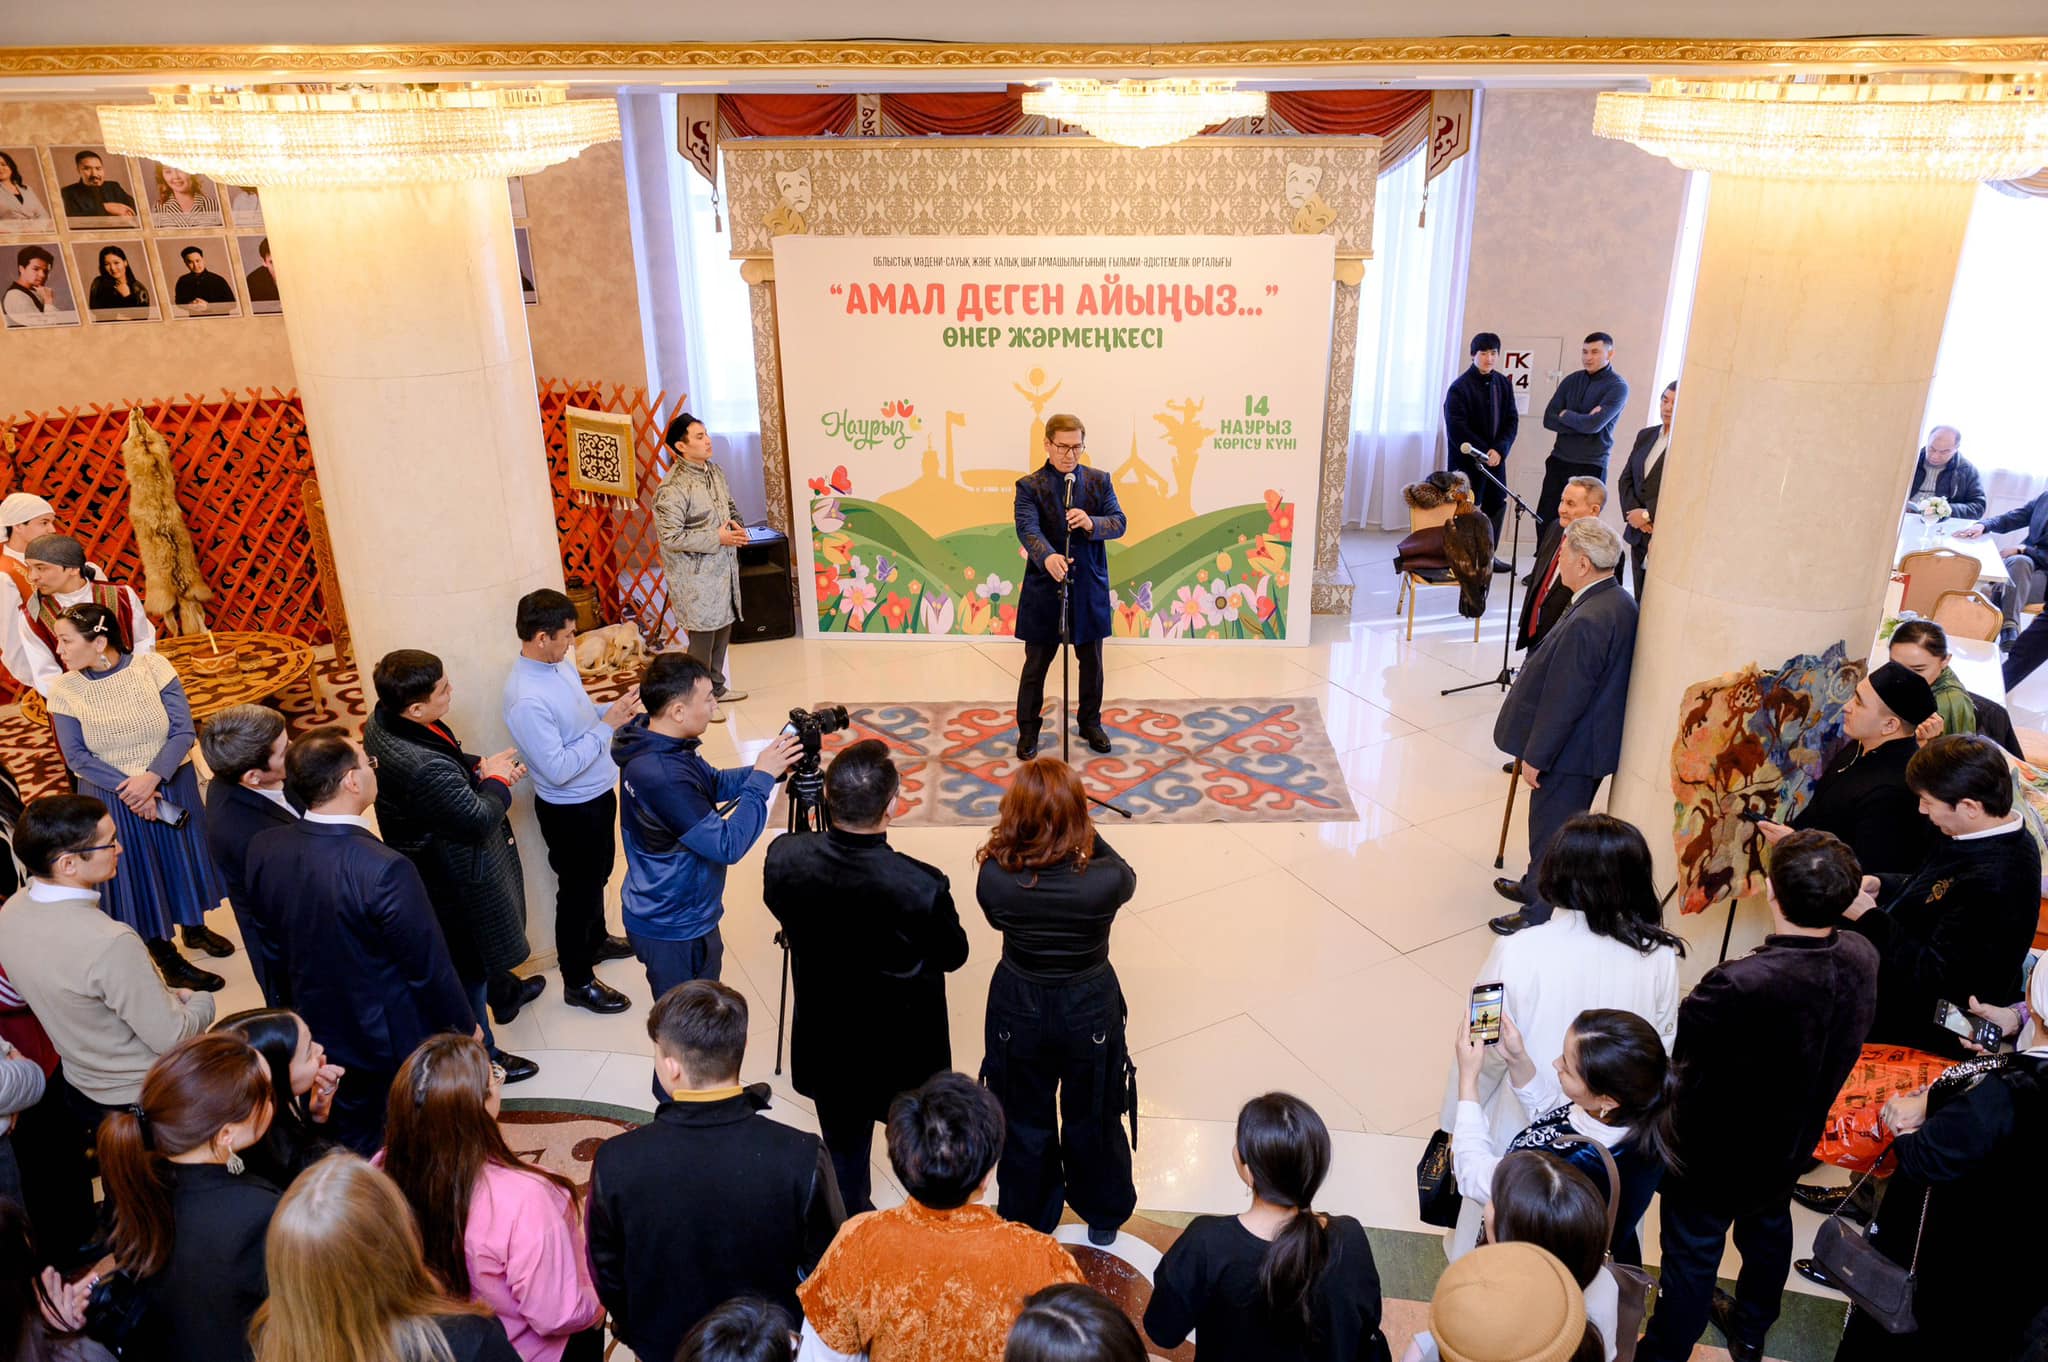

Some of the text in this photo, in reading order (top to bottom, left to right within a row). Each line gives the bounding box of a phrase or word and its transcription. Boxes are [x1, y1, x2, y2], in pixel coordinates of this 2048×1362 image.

[872, 256, 912, 268] ОБЛЫСТЫҚ
[972, 256, 992, 267] ЖӘНЕ
[994, 256, 1019, 268] ХАЛЫҚ
[1191, 256, 1232, 267] ОРТАЛЫҒЫ
[957, 283, 1064, 322] ДЕГЕН
[942, 327, 1163, 352] ӨНЕР ЖӘРМЕҢКЕСІ
[1245, 394, 1270, 416] 14
[821, 408, 912, 450] Наурыз
[1220, 419, 1292, 435] НАУРЫЗ
[1213, 438, 1297, 450] КӨРІСУ КҮНІ
